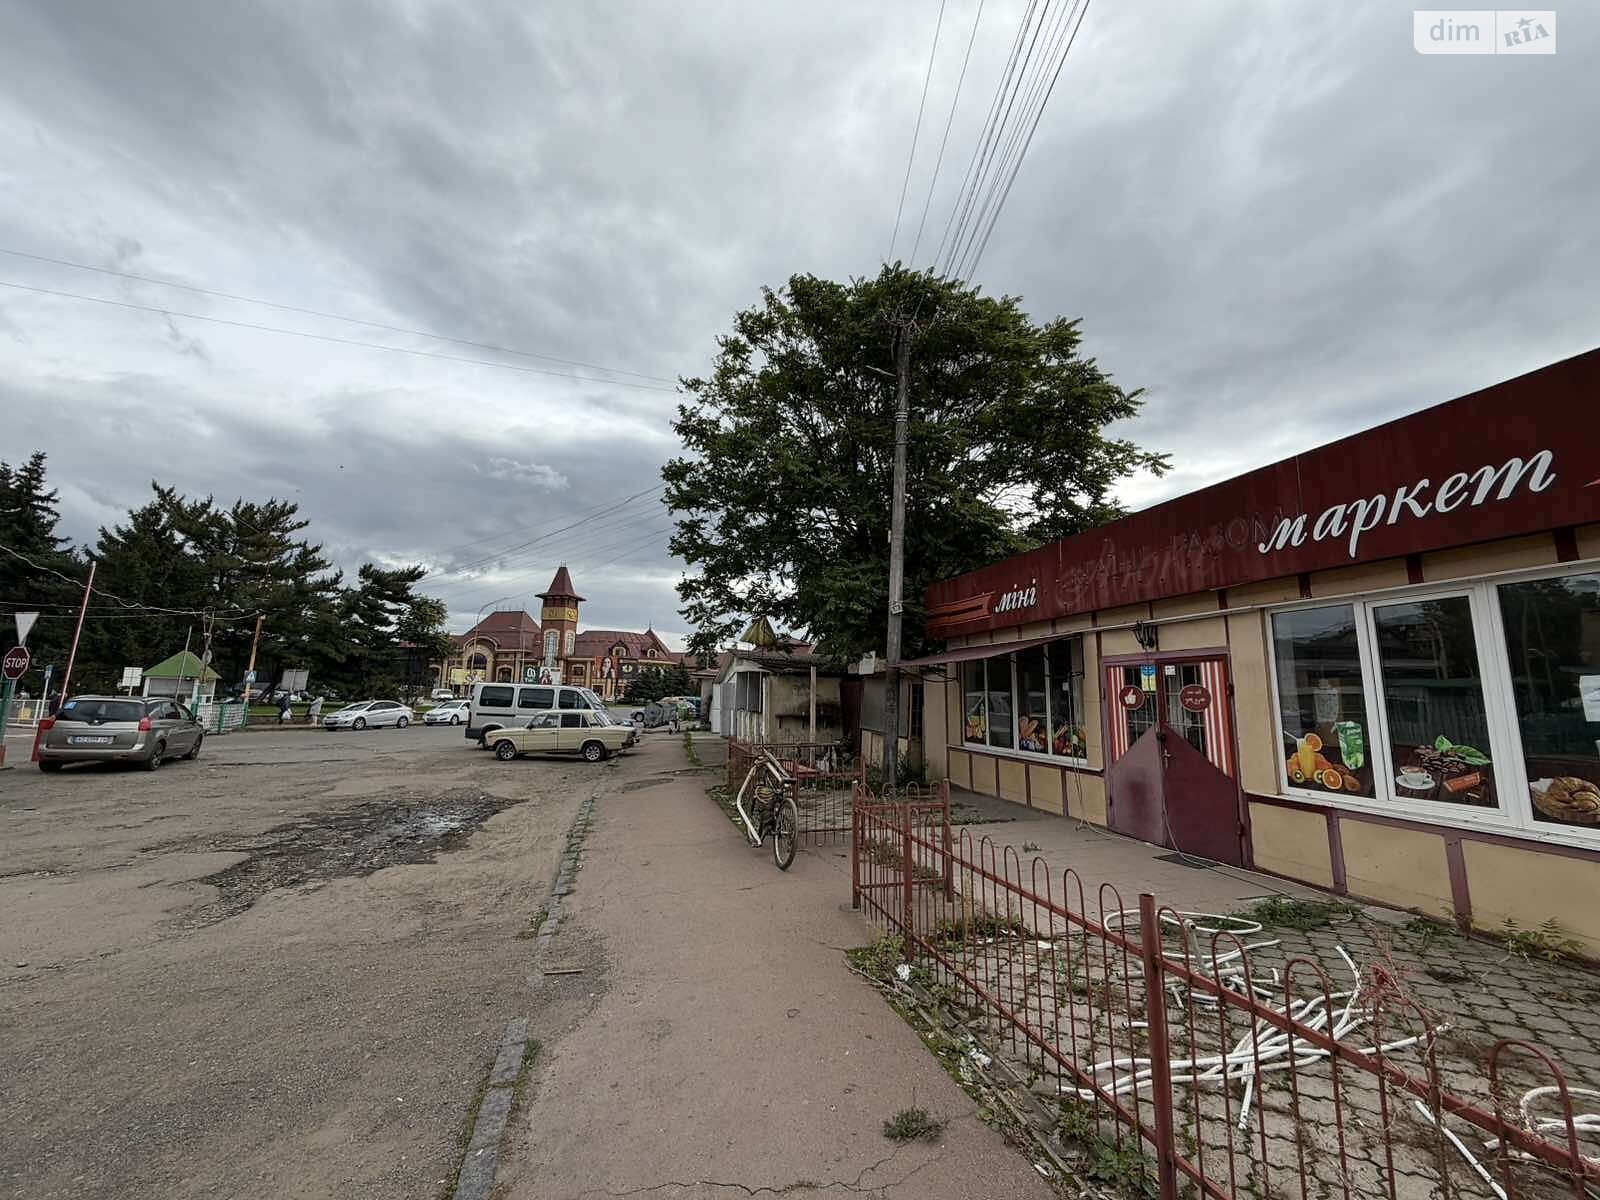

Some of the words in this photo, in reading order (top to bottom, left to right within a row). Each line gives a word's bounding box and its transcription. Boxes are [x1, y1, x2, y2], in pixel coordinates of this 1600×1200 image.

[994, 577, 1039, 614] міні
[1258, 448, 1557, 559] маркет
[5, 657, 27, 669] STOP
